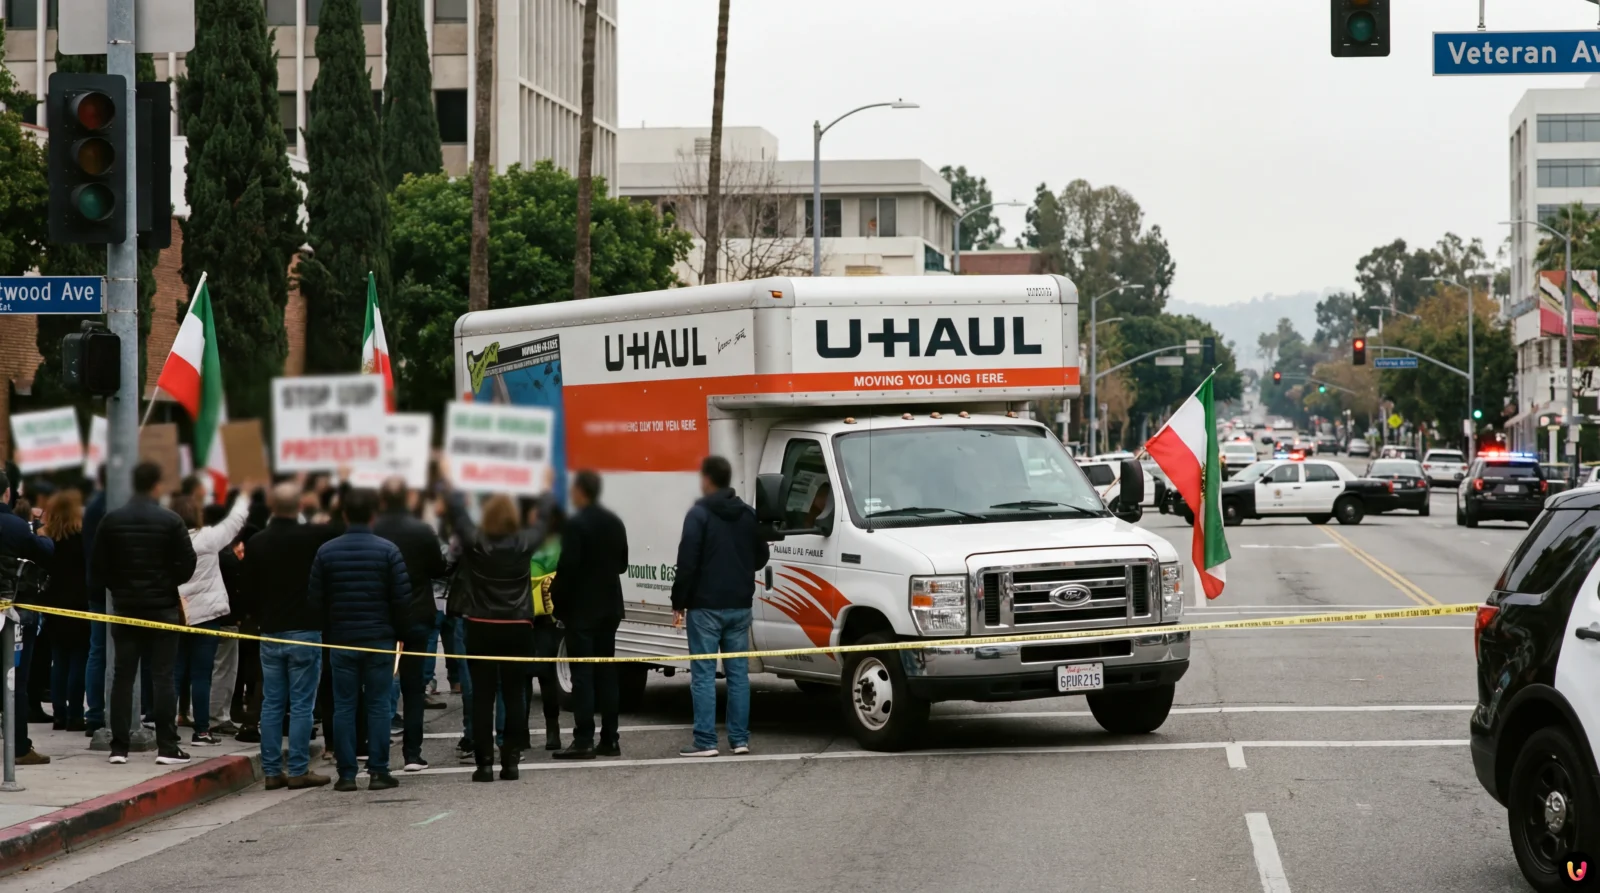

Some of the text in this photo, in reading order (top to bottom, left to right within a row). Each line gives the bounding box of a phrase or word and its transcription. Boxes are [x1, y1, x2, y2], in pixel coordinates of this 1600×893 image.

[1448, 41, 1557, 65] Veteran
[61, 282, 95, 301] Ave
[816, 316, 1042, 359] U-HAUL
[604, 326, 707, 372] U-HAUL
[854, 375, 904, 387] MOVING
[907, 374, 933, 386] YOU
[937, 373, 971, 385] LONG
[1060, 673, 1101, 688] 6PUR215
